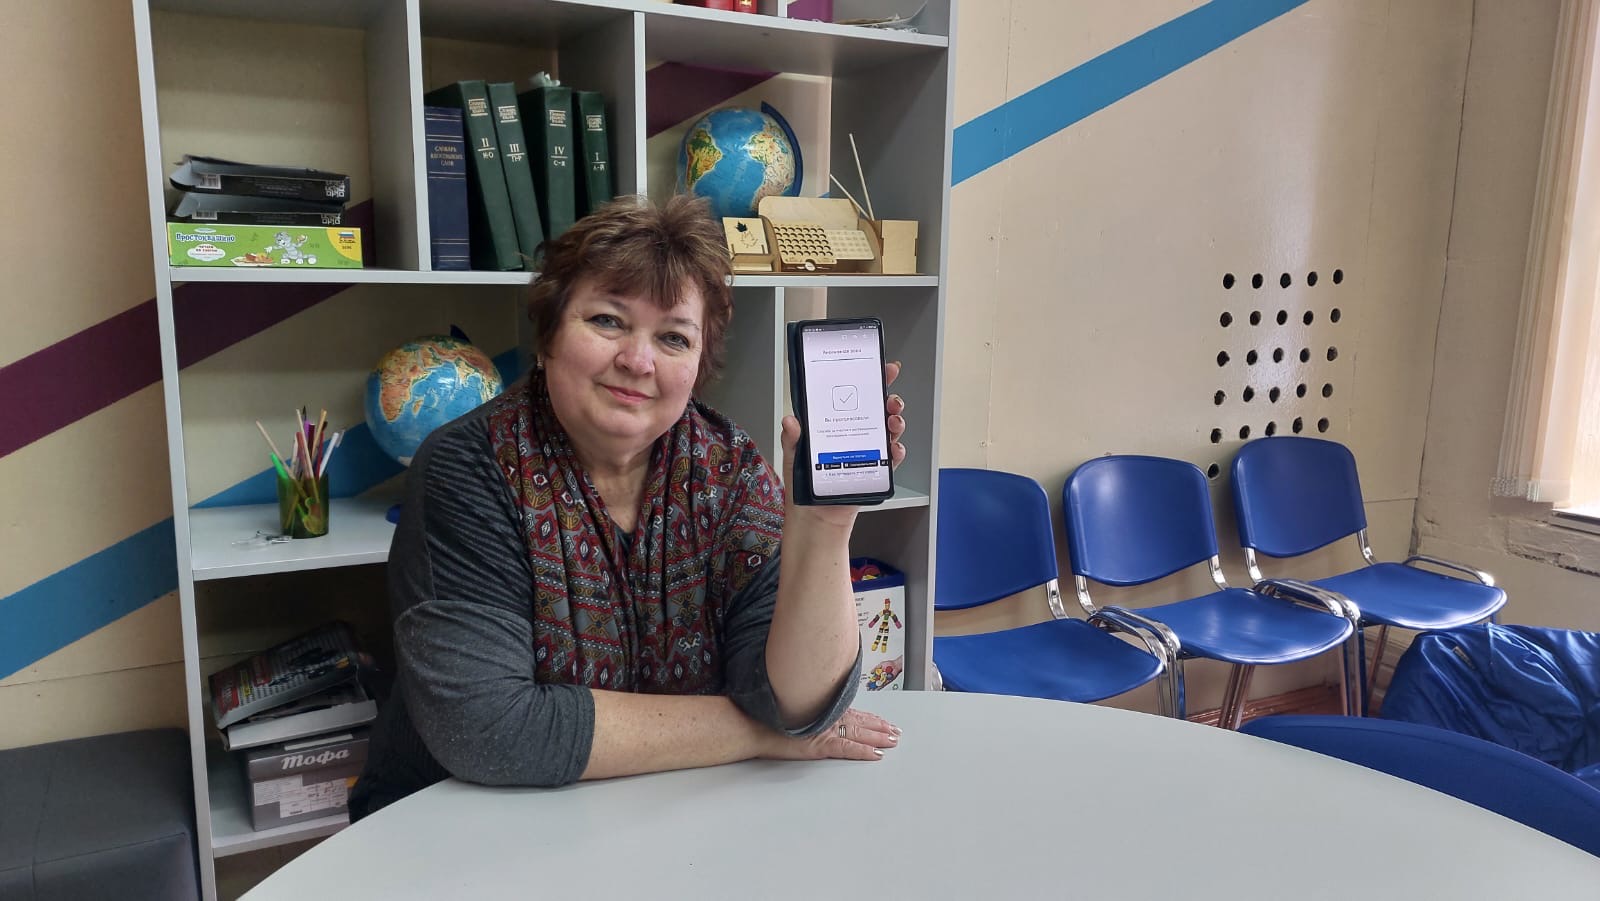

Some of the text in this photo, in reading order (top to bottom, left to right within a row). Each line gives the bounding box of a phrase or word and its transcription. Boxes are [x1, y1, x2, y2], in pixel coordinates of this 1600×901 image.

[481, 137, 490, 148] II
[509, 143, 520, 153] III
[554, 145, 565, 155] IV
